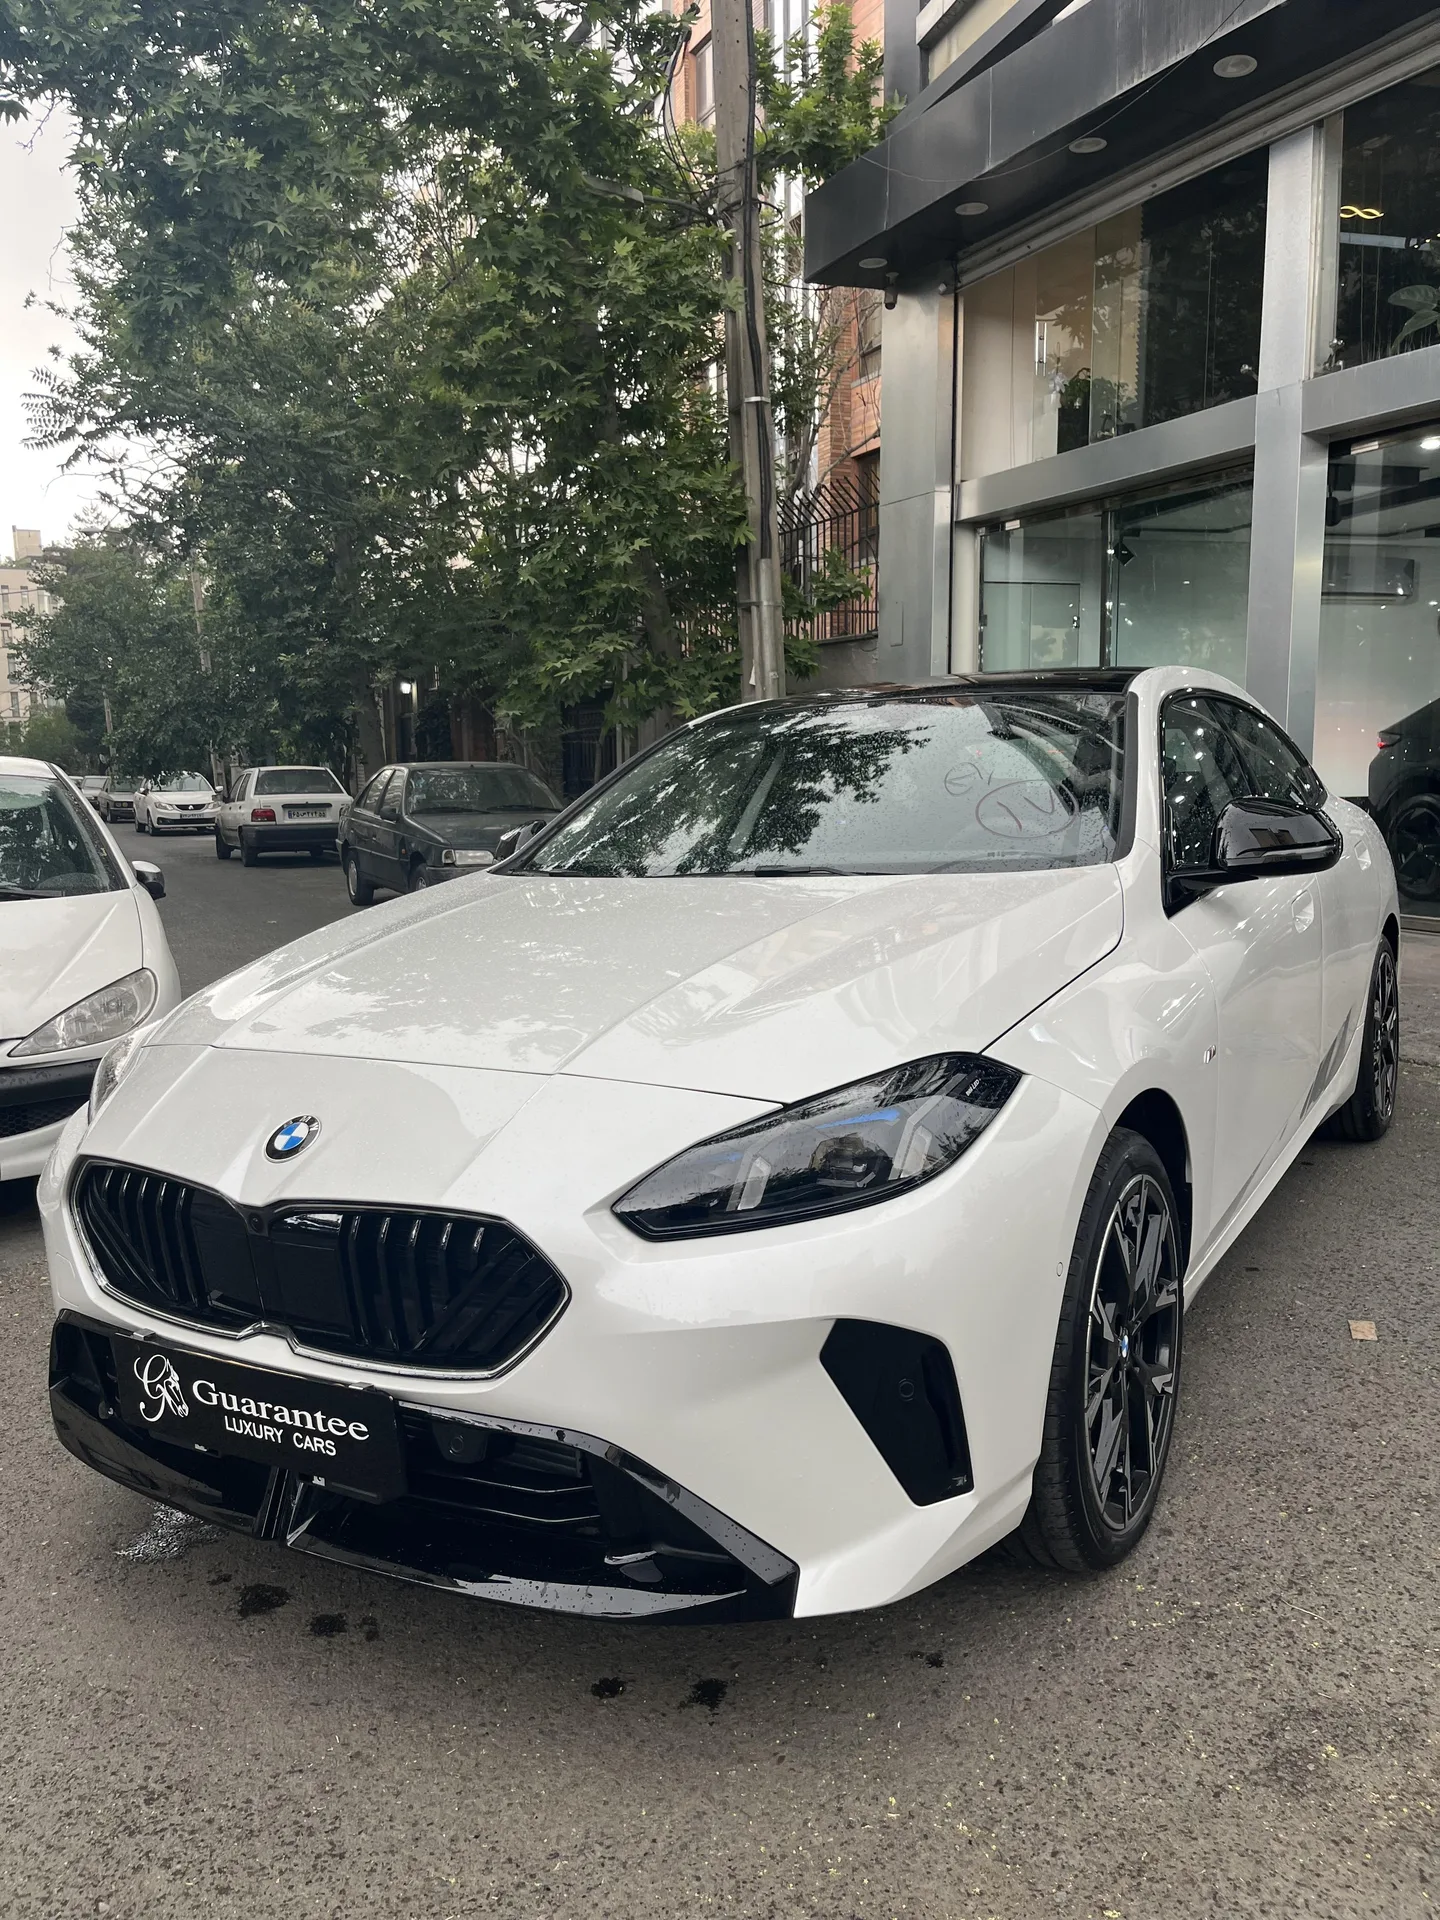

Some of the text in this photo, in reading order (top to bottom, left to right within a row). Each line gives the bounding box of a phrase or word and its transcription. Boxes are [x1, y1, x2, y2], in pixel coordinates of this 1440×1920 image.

[192, 1379, 370, 1441] Guarantee
[224, 1415, 337, 1457] LUXURY CARS
